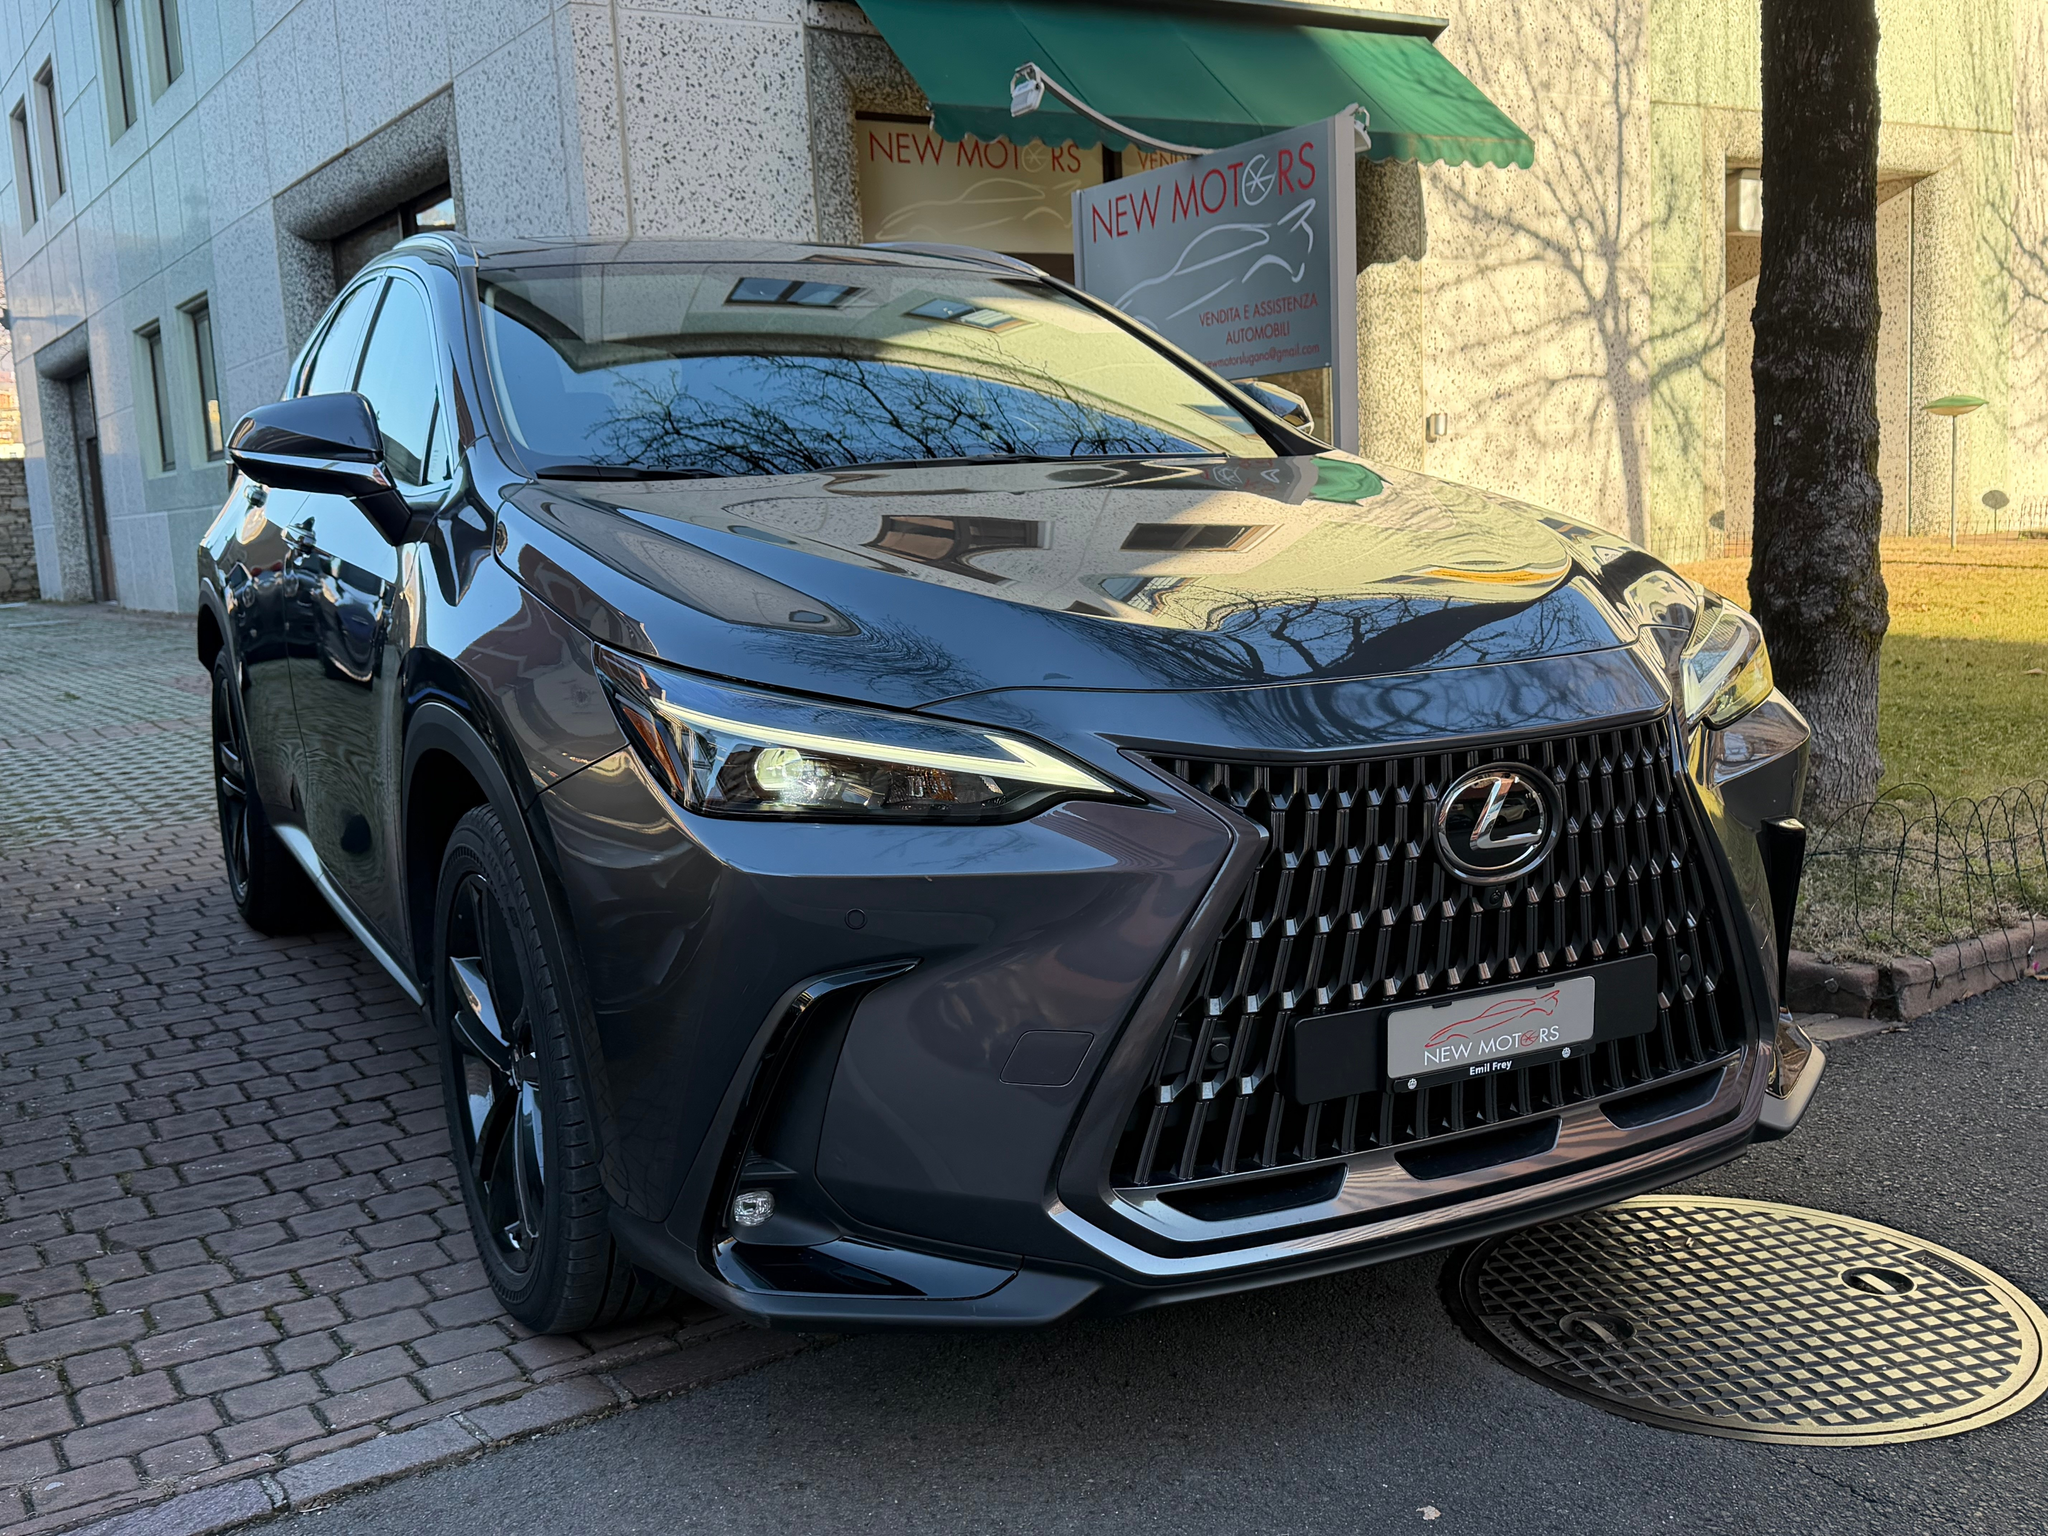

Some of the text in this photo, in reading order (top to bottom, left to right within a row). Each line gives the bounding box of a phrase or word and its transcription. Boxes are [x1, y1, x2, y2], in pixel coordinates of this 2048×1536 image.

[868, 131, 944, 166] NEW
[1091, 141, 1317, 244] NEW MOTORS
[1199, 292, 1319, 327] VENDITA E ASSISTENZA
[1225, 321, 1291, 346] AUTOMOBILI
[1423, 1025, 1561, 1067] NEW MOTORS
[1469, 1060, 1513, 1076] Emil Frey
